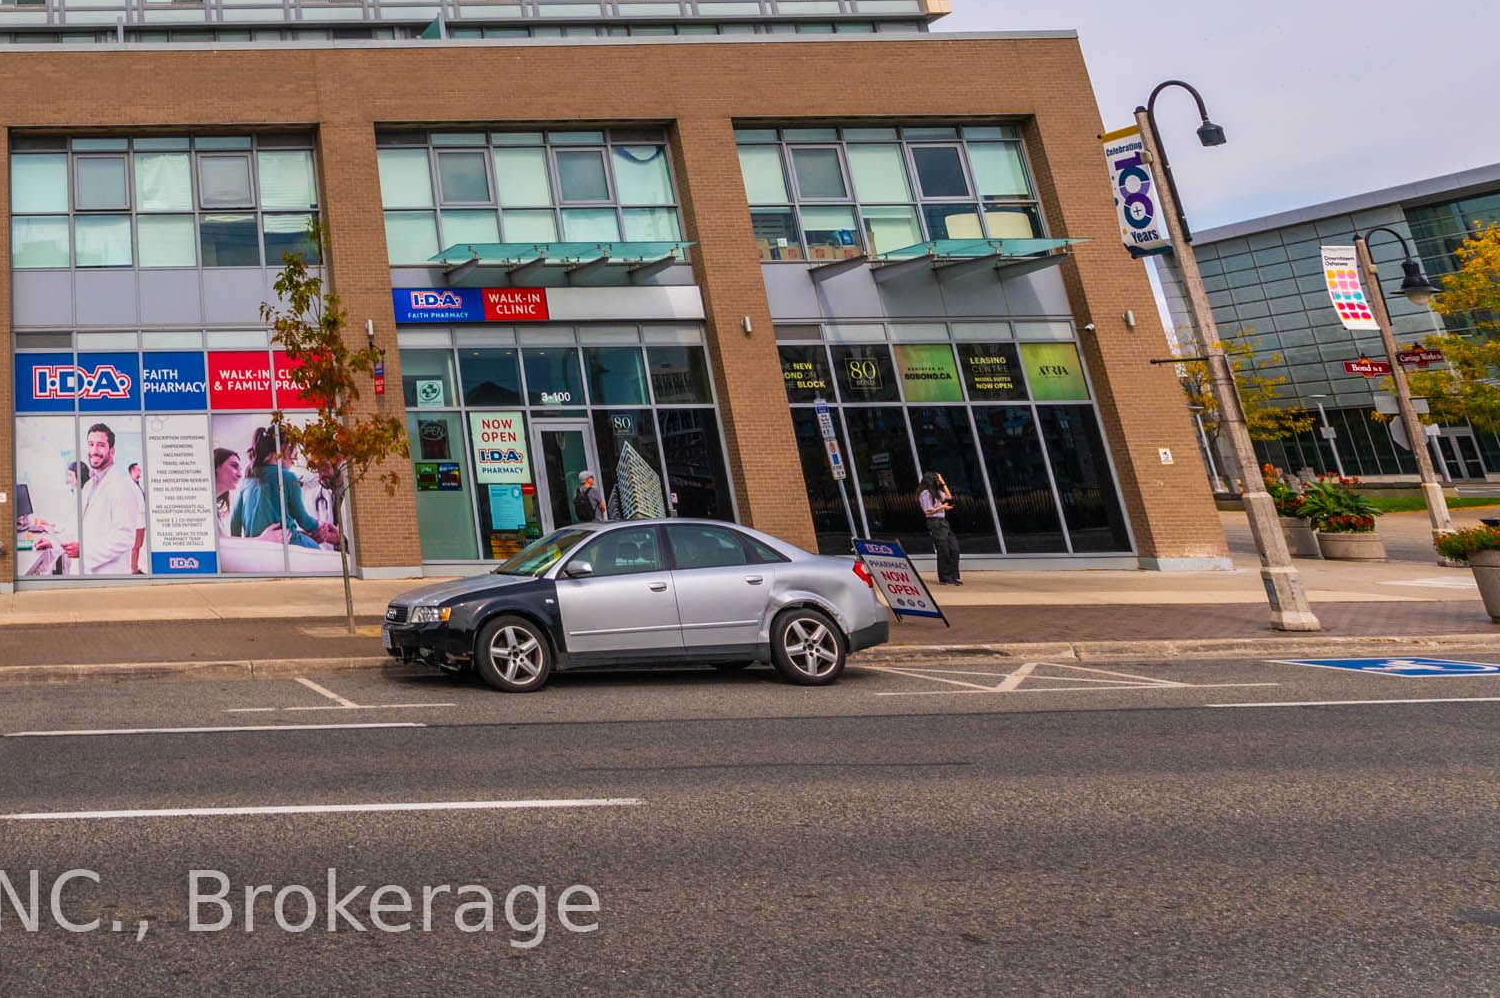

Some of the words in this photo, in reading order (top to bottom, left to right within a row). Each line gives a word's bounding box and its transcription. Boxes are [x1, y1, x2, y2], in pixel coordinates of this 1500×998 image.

[1106, 142, 1142, 156] Celebrating
[1131, 230, 1159, 243] Years
[488, 293, 541, 304] WALK-IN
[496, 304, 537, 315] CLINIC
[793, 362, 813, 370] NEW
[850, 361, 877, 379] 80
[971, 365, 1010, 373] CENTRE
[1351, 363, 1372, 372] Bond
[143, 369, 178, 380] FAITH
[219, 369, 270, 380] WALK-IN
[784, 372, 803, 380] OND
[143, 381, 207, 393] PHARMACY
[214, 381, 223, 391] &
[227, 381, 270, 391] FAMILY
[797, 381, 826, 389] BLOCK
[540, 391, 571, 402] 3-100
[482, 419, 513, 430] NOW
[614, 416, 631, 428] 80
[481, 432, 517, 443] OPEN
[868, 560, 908, 570] PHARMACY
[880, 570, 910, 583] NOW
[887, 583, 922, 596] OPEN
